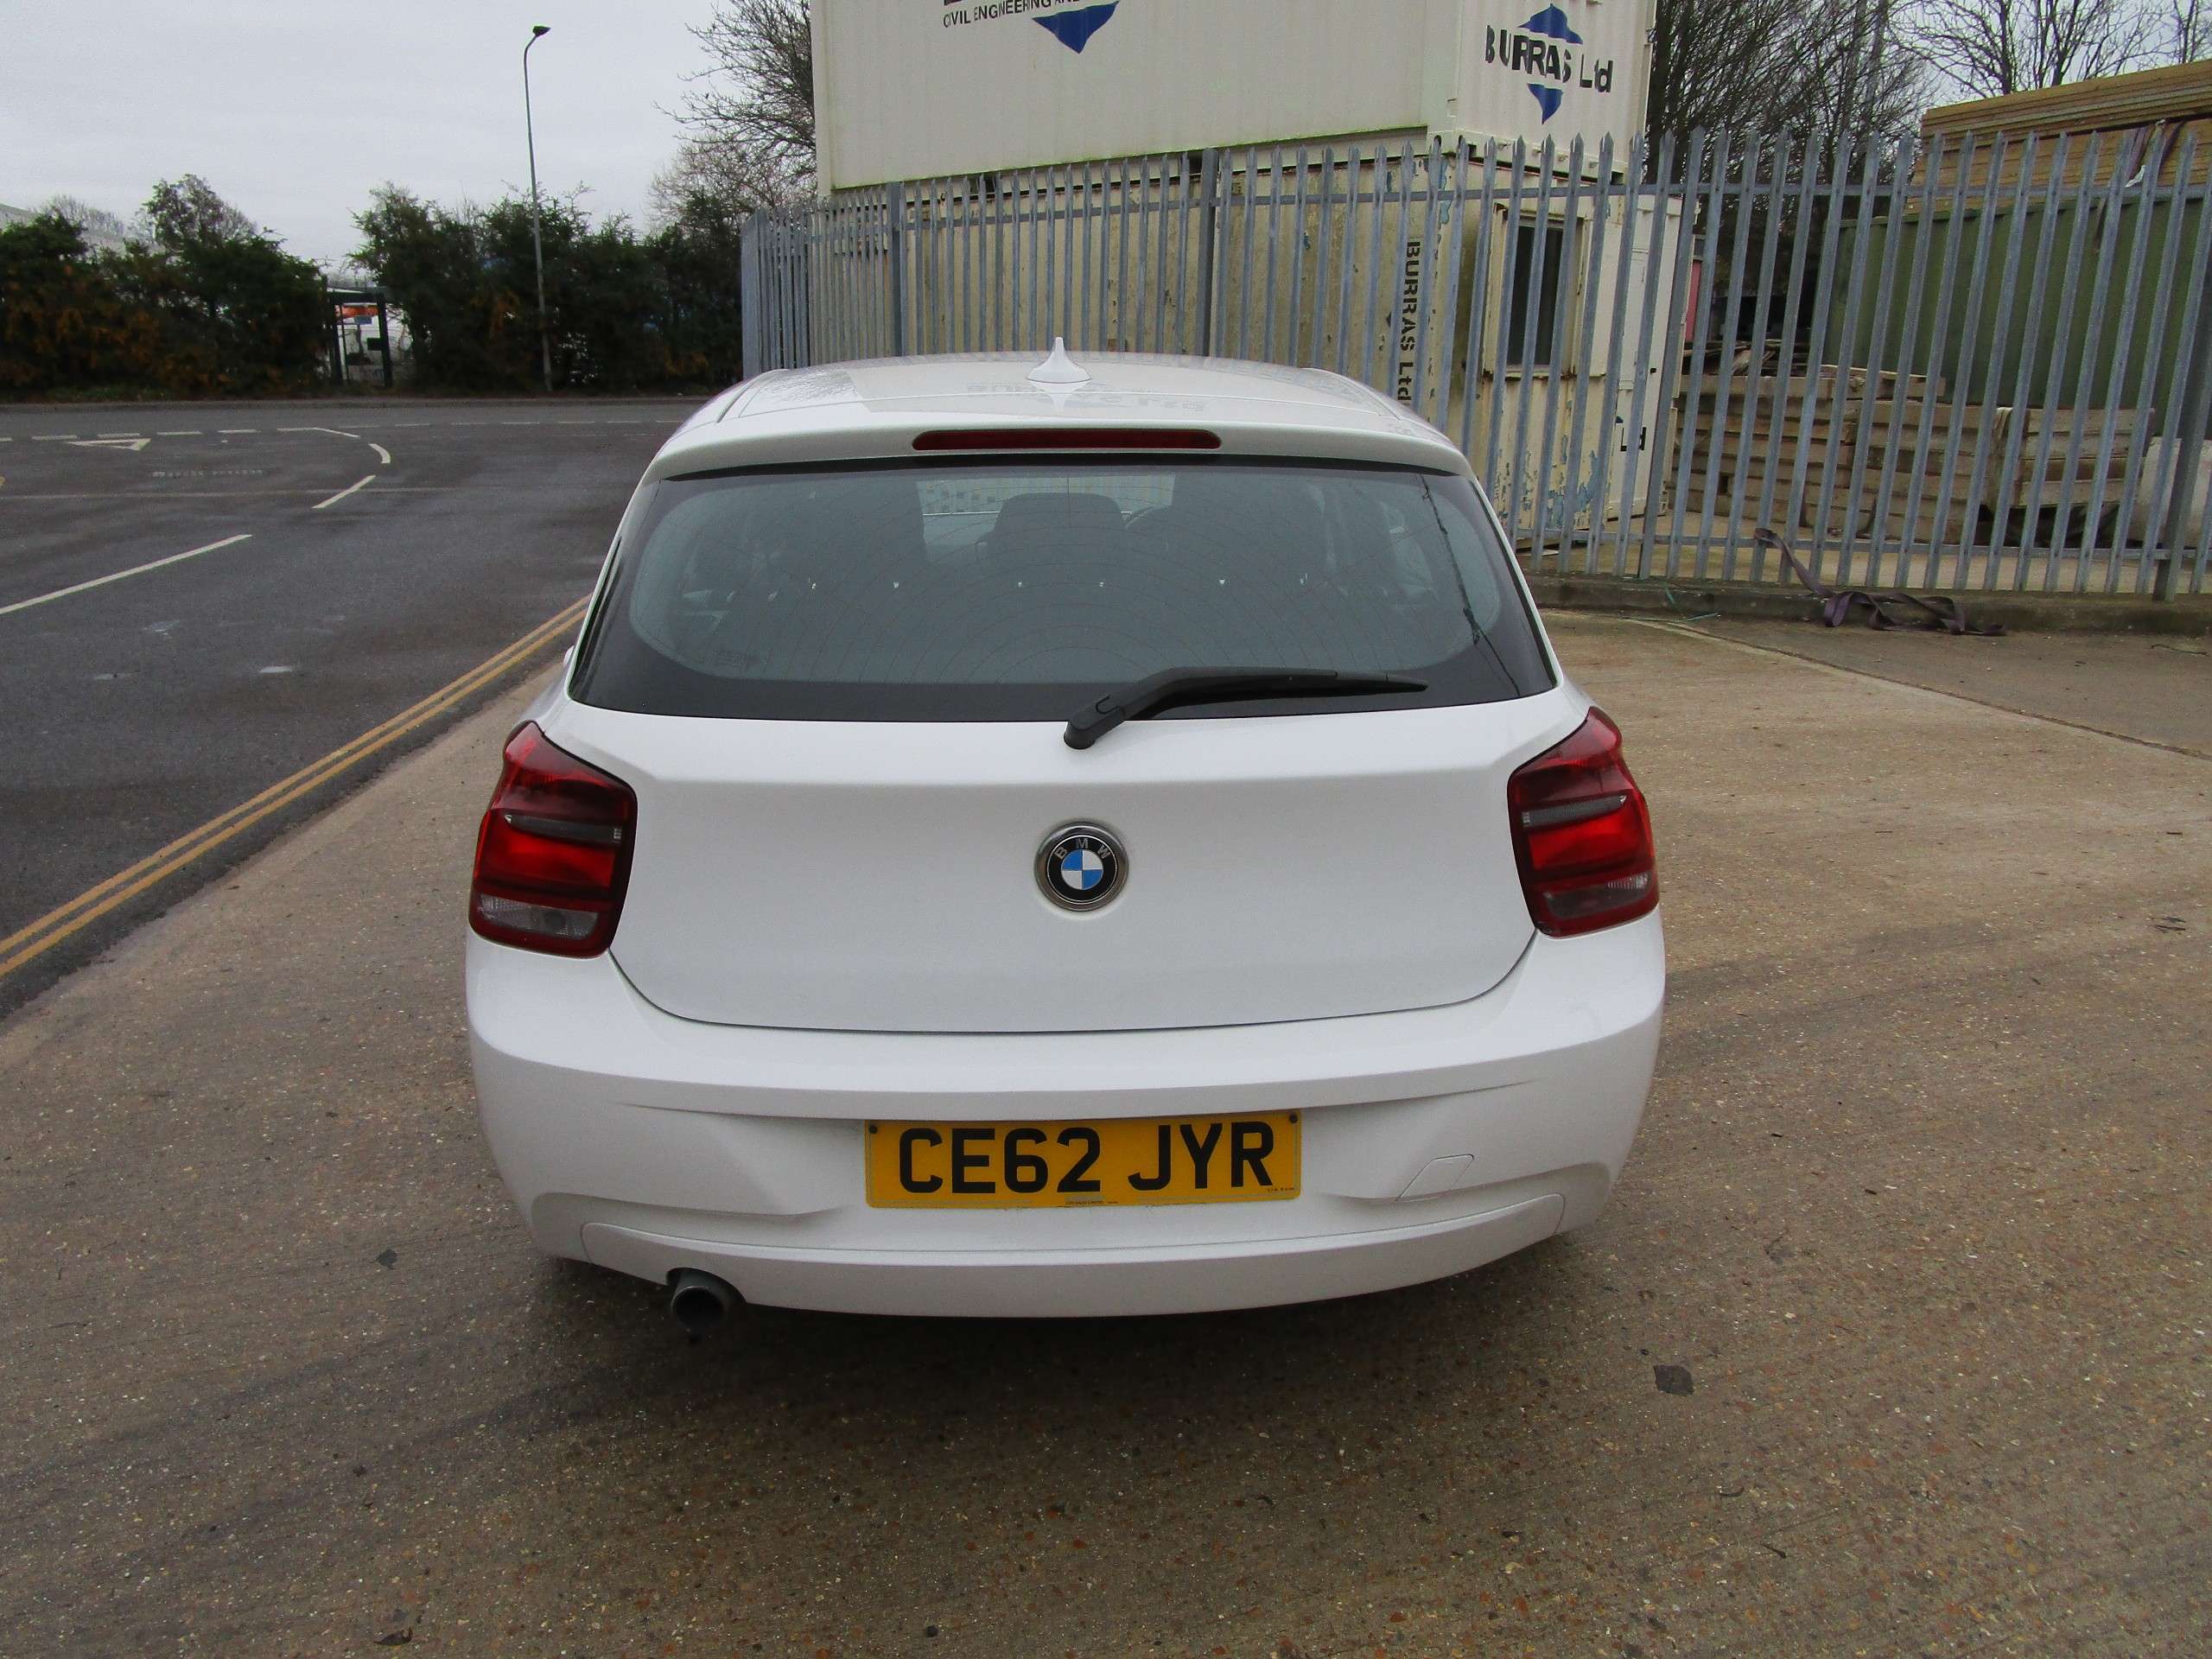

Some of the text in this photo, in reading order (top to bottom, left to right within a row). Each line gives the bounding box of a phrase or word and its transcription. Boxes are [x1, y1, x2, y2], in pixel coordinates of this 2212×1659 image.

[943, 10, 971, 29] CIVIL
[1484, 24, 1614, 93] BURRAS Ltd
[1397, 241, 1421, 401] BURRAS Ltd
[1054, 837, 1111, 860] BMW
[899, 1121, 1274, 1194] CE62 JYR
